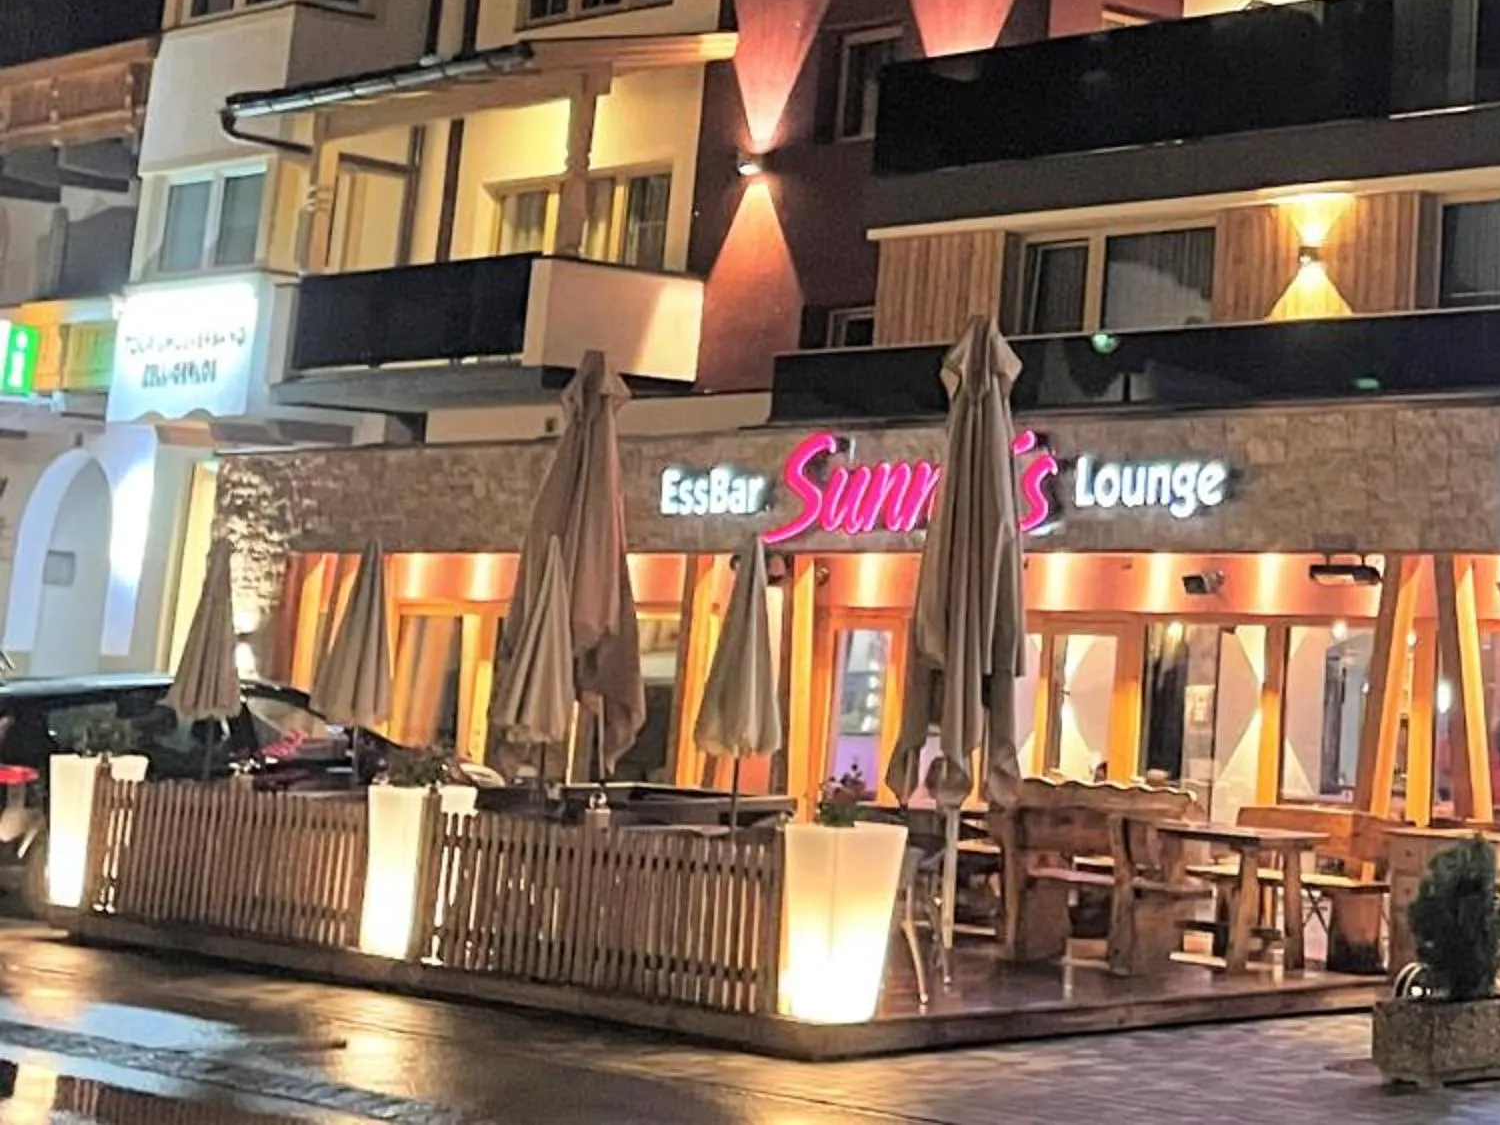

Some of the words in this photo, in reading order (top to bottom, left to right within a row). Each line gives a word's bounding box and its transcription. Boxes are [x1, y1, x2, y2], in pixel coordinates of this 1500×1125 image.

[660, 467, 765, 515] EssBar
[762, 431, 1058, 543] Sunn's
[1074, 454, 1226, 518] Lounge
